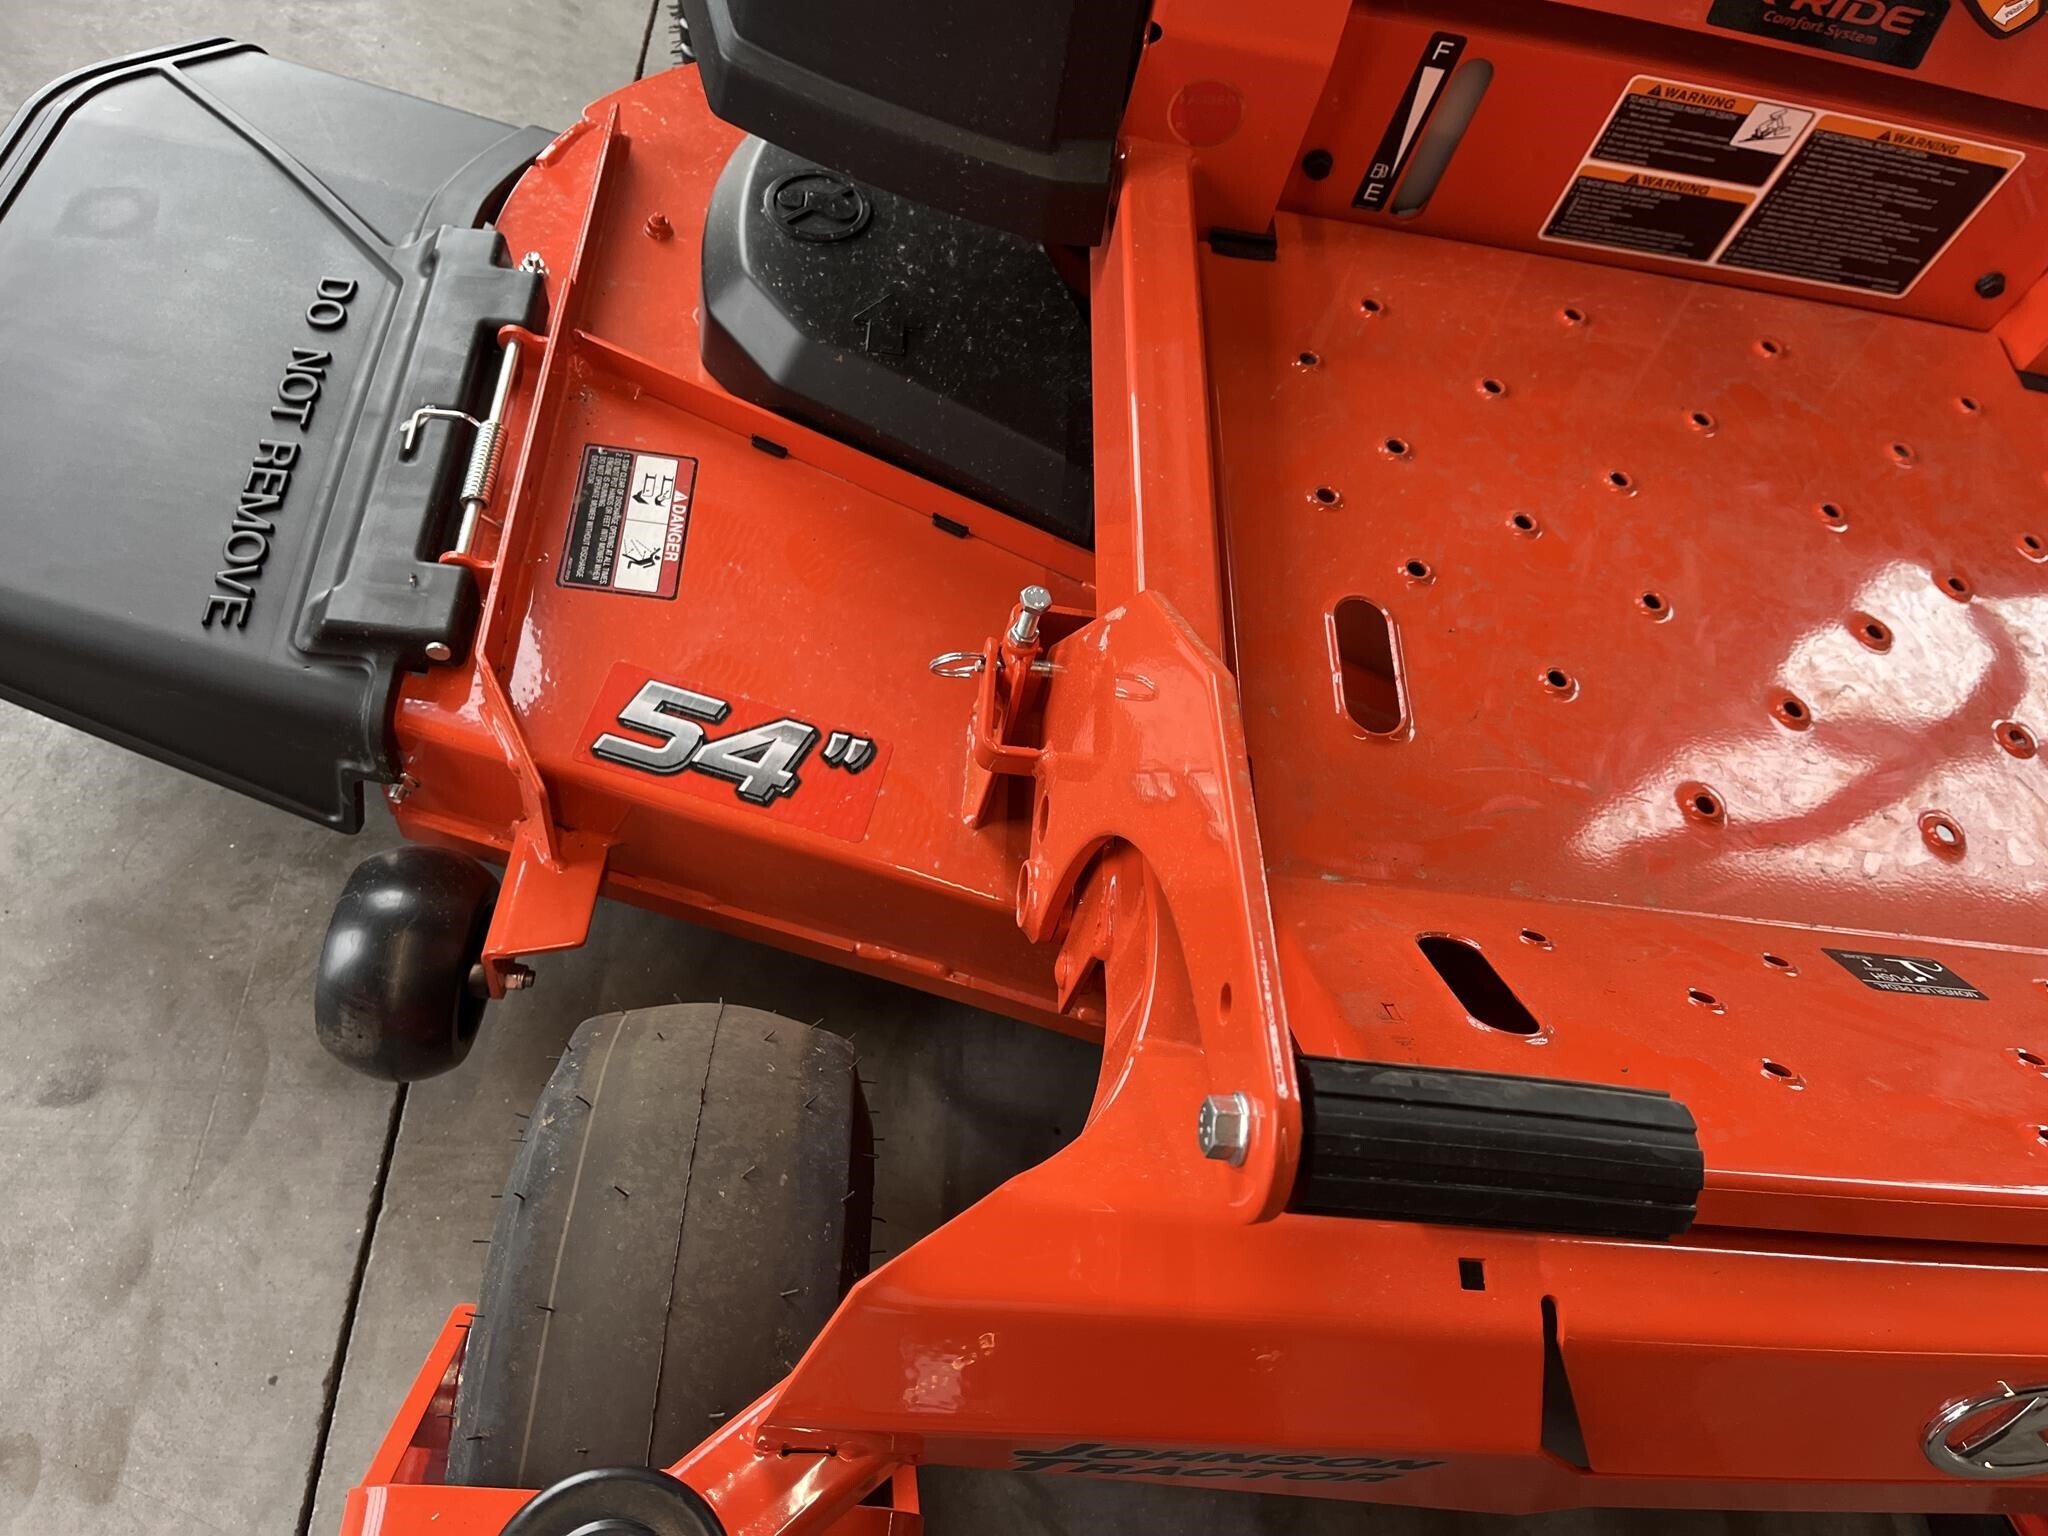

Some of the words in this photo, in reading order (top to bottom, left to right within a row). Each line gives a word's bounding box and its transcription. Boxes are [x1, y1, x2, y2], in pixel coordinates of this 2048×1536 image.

[1763, 10, 1824, 33] Comfort
[1824, 24, 1878, 45] System
[1432, 41, 1455, 61] F
[1664, 86, 1736, 109] WARNING
[1894, 132, 1960, 154] WARNING
[1363, 183, 1384, 201] E
[1641, 175, 1711, 196] WARNING
[306, 276, 358, 332] DO
[271, 347, 332, 432] NOT
[596, 464, 605, 475] NOT
[603, 456, 614, 476] ENGINE
[591, 475, 602, 498] OPERATE
[617, 471, 627, 488] CLEAR
[605, 487, 616, 506] HANDS
[587, 499, 598, 520] MOWER
[604, 506, 613, 514] OR
[610, 495, 623, 525] DISCHARGE
[601, 514, 611, 527] FEET
[202, 439, 301, 628] REMOVE
[581, 520, 594, 546] WITHOUT
[599, 528, 609, 541] INTO
[606, 525, 617, 548] OPENING
[664, 503, 686, 561] DANGER
[575, 546, 589, 578] DISCHARGE
[595, 542, 606, 563] MOWER
[602, 555, 612, 566] ALL
[591, 563, 602, 580] WHEN
[1869, 972, 1913, 983] PUSH
[1911, 986, 1933, 994] LIFT
[1013, 1443, 1448, 1470] JOHNSON
[1012, 1458, 1402, 1482] TRACTOR
